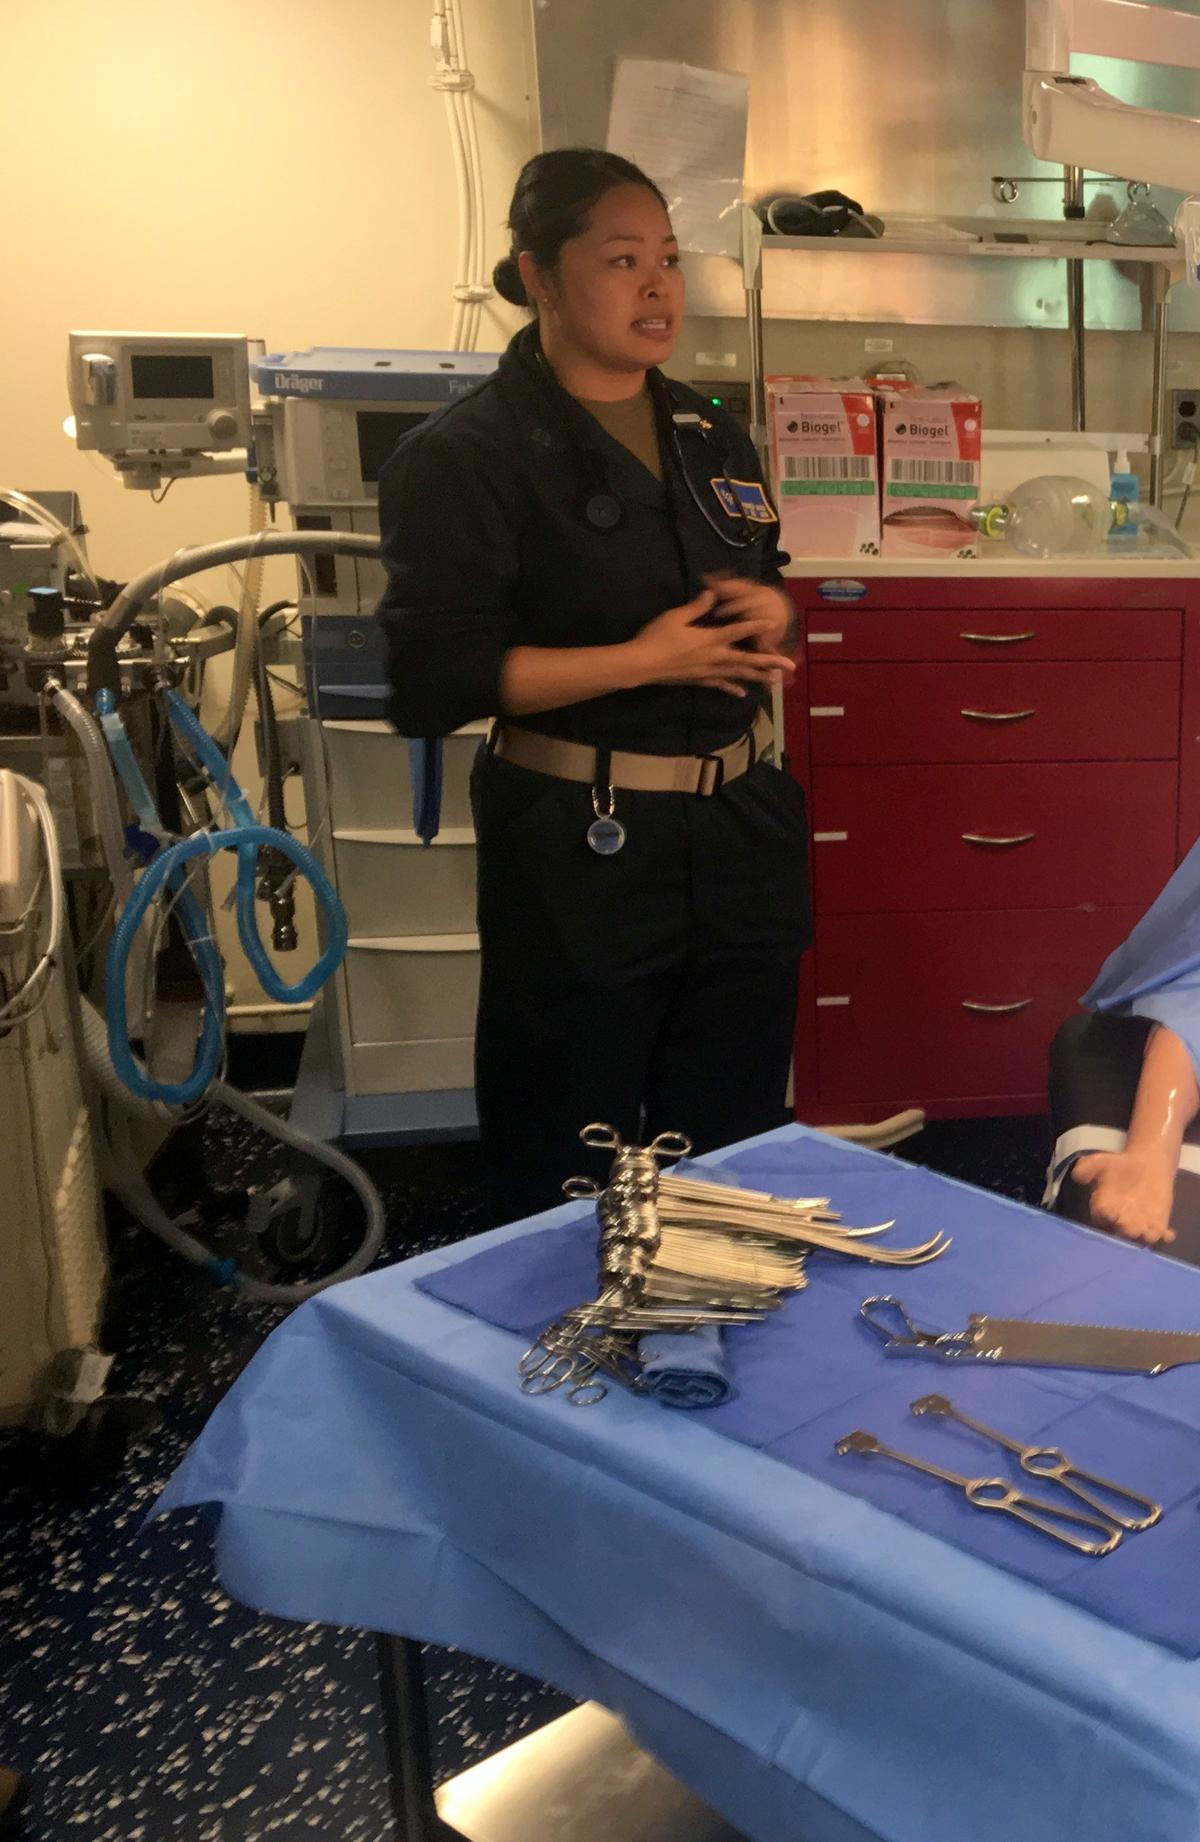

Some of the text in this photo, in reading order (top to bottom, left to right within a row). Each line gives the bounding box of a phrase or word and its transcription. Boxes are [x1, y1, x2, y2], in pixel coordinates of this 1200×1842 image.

[274, 373, 324, 393] Dräger
[801, 421, 841, 436] Biogel
[909, 423, 949, 439] Biogel
